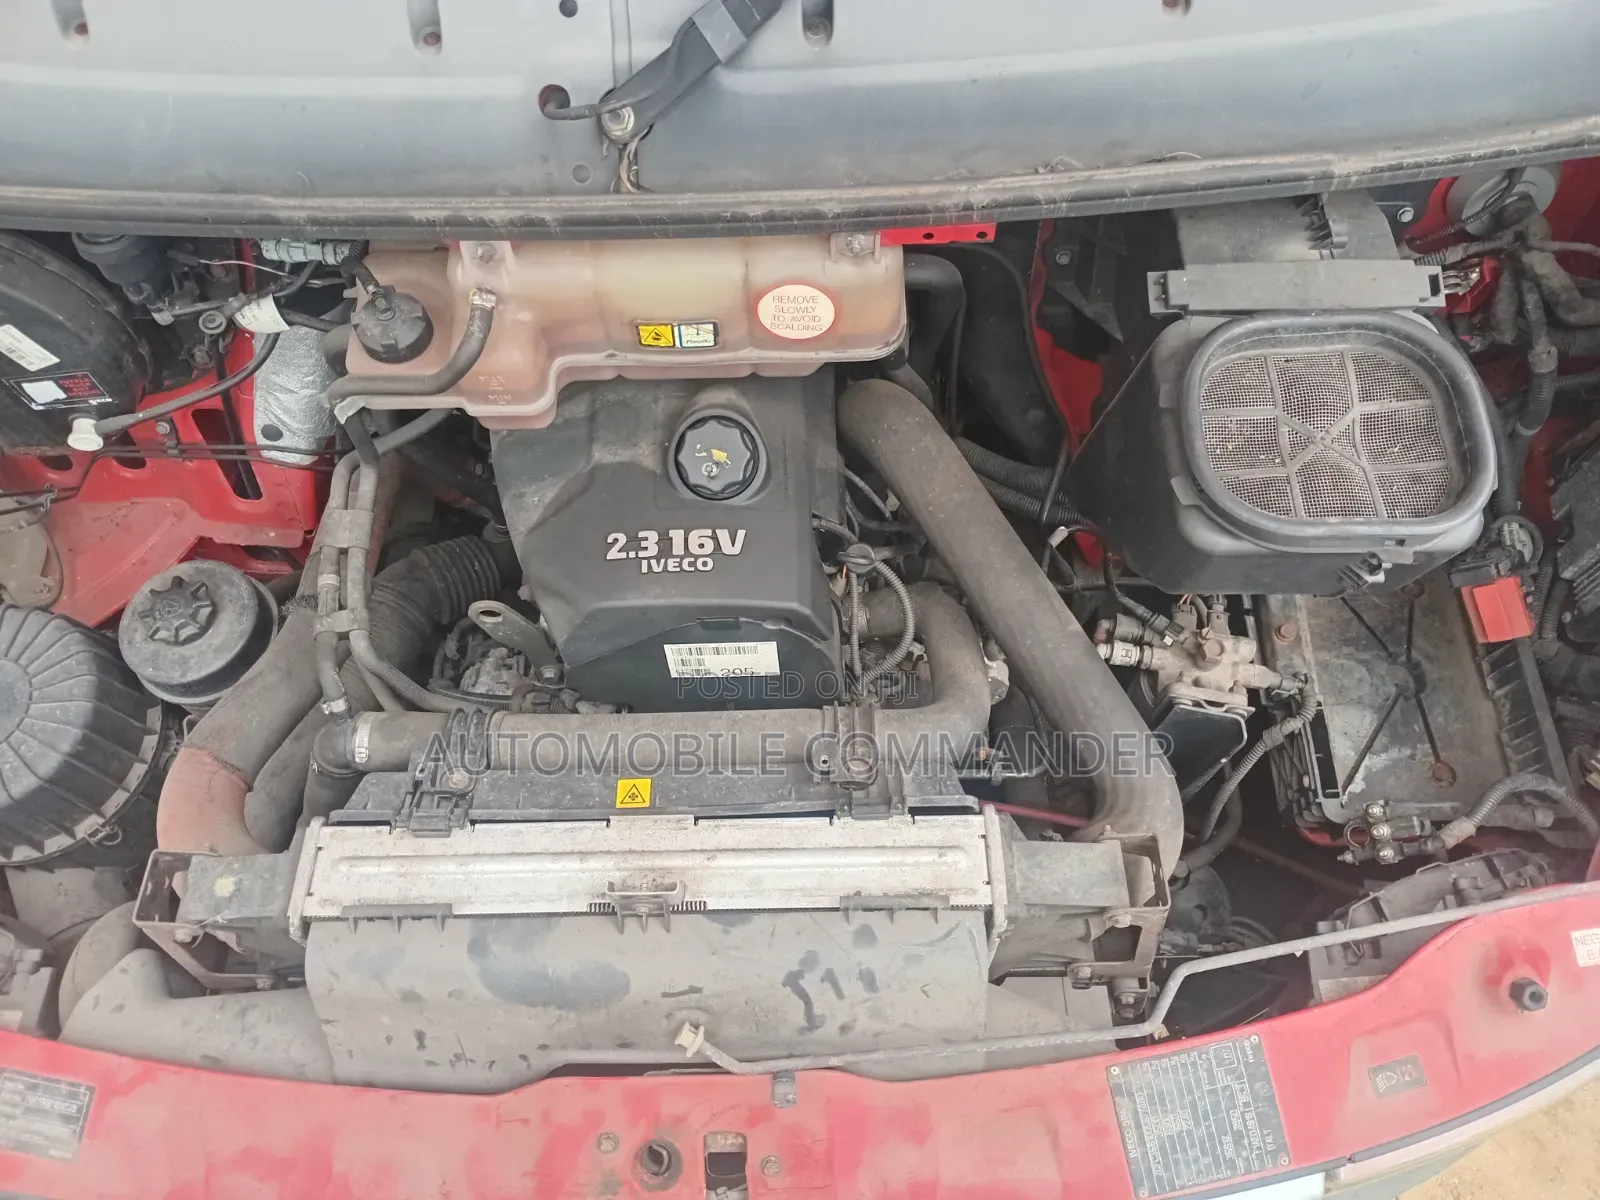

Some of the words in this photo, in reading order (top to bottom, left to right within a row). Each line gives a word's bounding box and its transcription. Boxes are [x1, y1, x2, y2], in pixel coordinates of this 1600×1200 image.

[772, 295, 819, 304] REMOVE
[774, 305, 817, 314] SLOWLY
[772, 314, 786, 322] TO
[790, 315, 821, 323] AVOID
[770, 323, 823, 332] SCALDING
[606, 532, 660, 560] 2.3
[669, 528, 747, 556] 16V
[640, 557, 714, 573] IVECO
[1243, 1040, 1255, 1063] IVECO
[1118, 1108, 1130, 1126] SPA
[1123, 1128, 1137, 1158] IVECO
